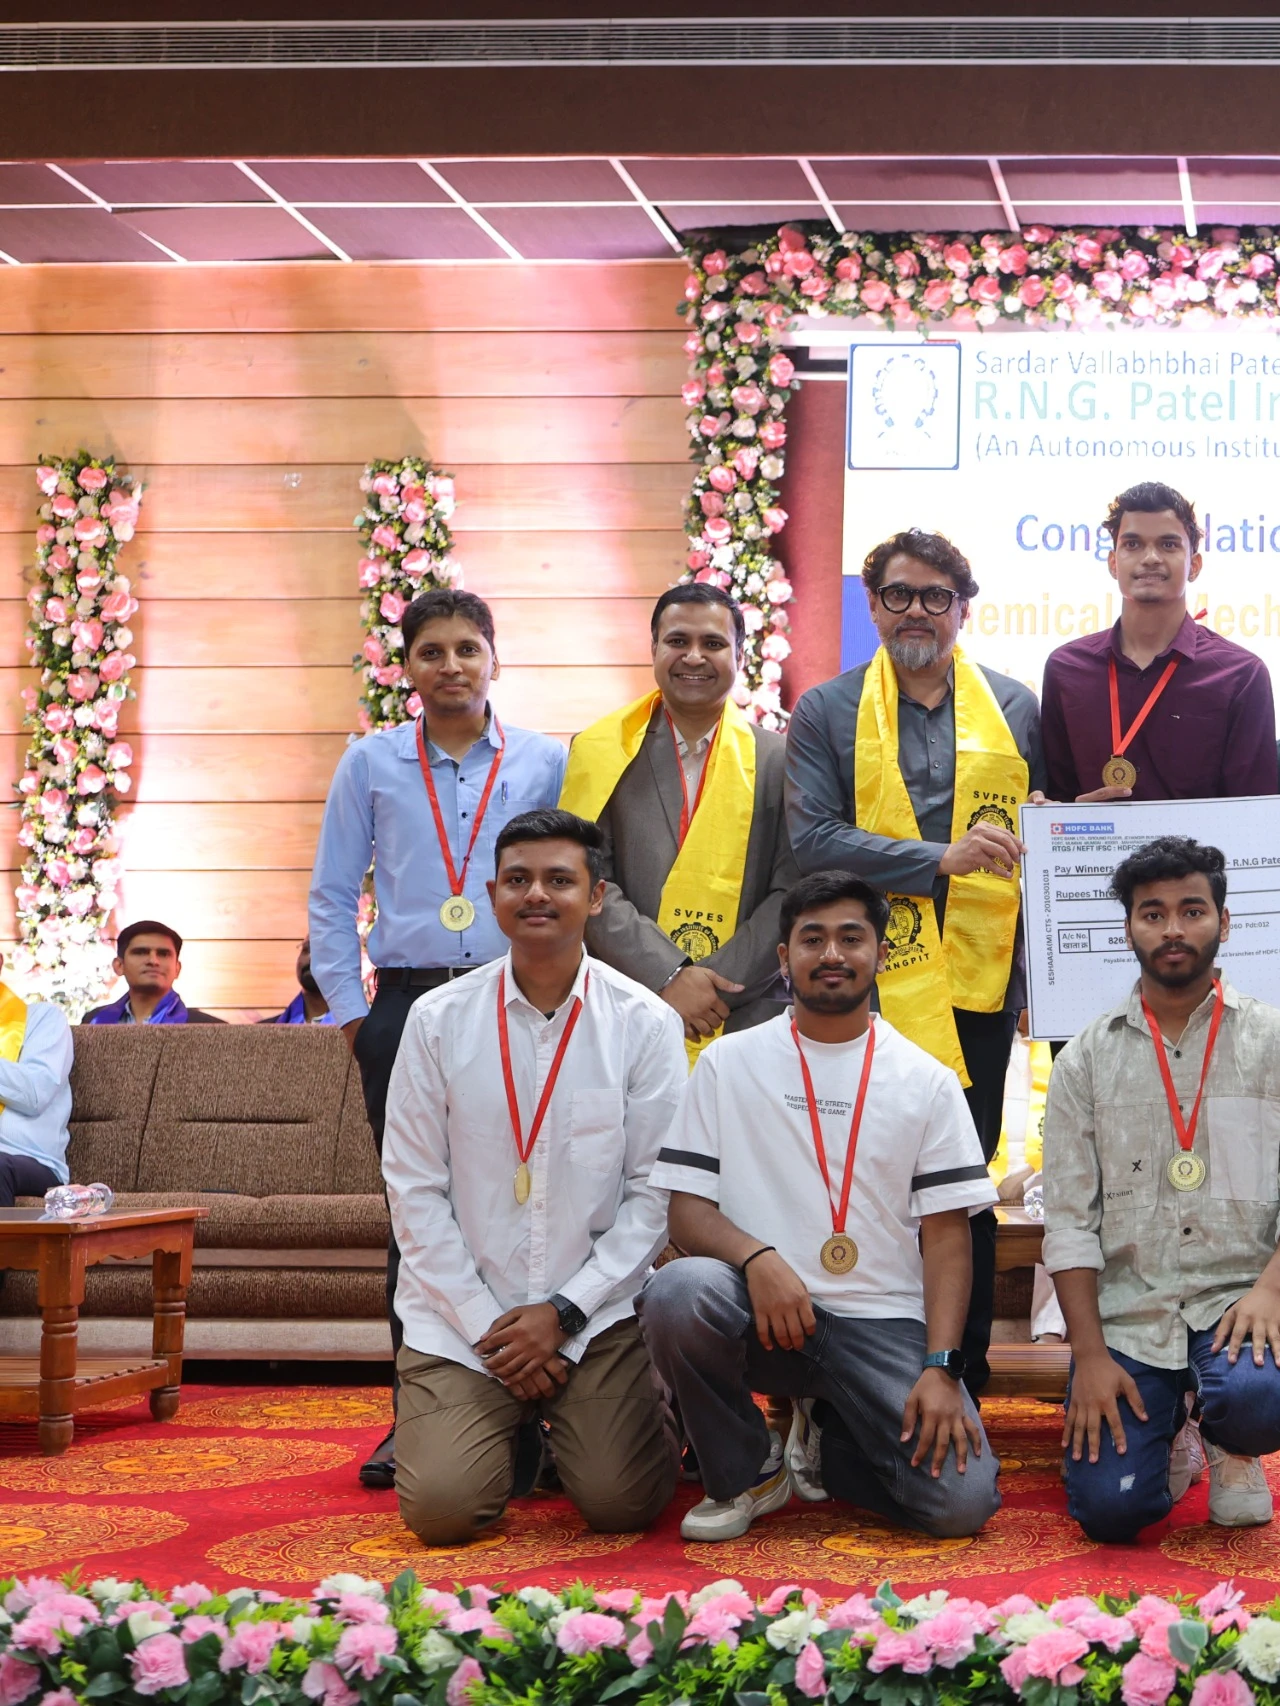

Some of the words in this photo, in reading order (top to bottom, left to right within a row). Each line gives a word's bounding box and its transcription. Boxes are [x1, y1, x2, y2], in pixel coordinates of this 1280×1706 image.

[976, 350, 1059, 374] Sardar
[1068, 350, 1219, 375] Vallabhbhai
[975, 380, 1110, 421] R.N.G.
[1130, 379, 1236, 422] Patel
[976, 432, 1018, 461] (An
[1029, 435, 1196, 458] Autonomous
[966, 592, 1113, 636] emical
[973, 790, 1017, 805] SVPES
[1054, 865, 1071, 874] Pay
[1075, 865, 1115, 873] Winners
[1233, 857, 1259, 867] R.N.G
[1042, 869, 1052, 913] 2010301018
[1056, 890, 1091, 900] Rupees
[1093, 890, 1117, 898] Thre
[674, 908, 724, 922] SVPES
[885, 952, 930, 972] RNGPIT
[1047, 933, 1055, 986] SESHAASA(M)
[784, 1094, 808, 1103] MASTE
[824, 1100, 852, 1109] STREETS
[786, 1102, 809, 1112] RESPEC
